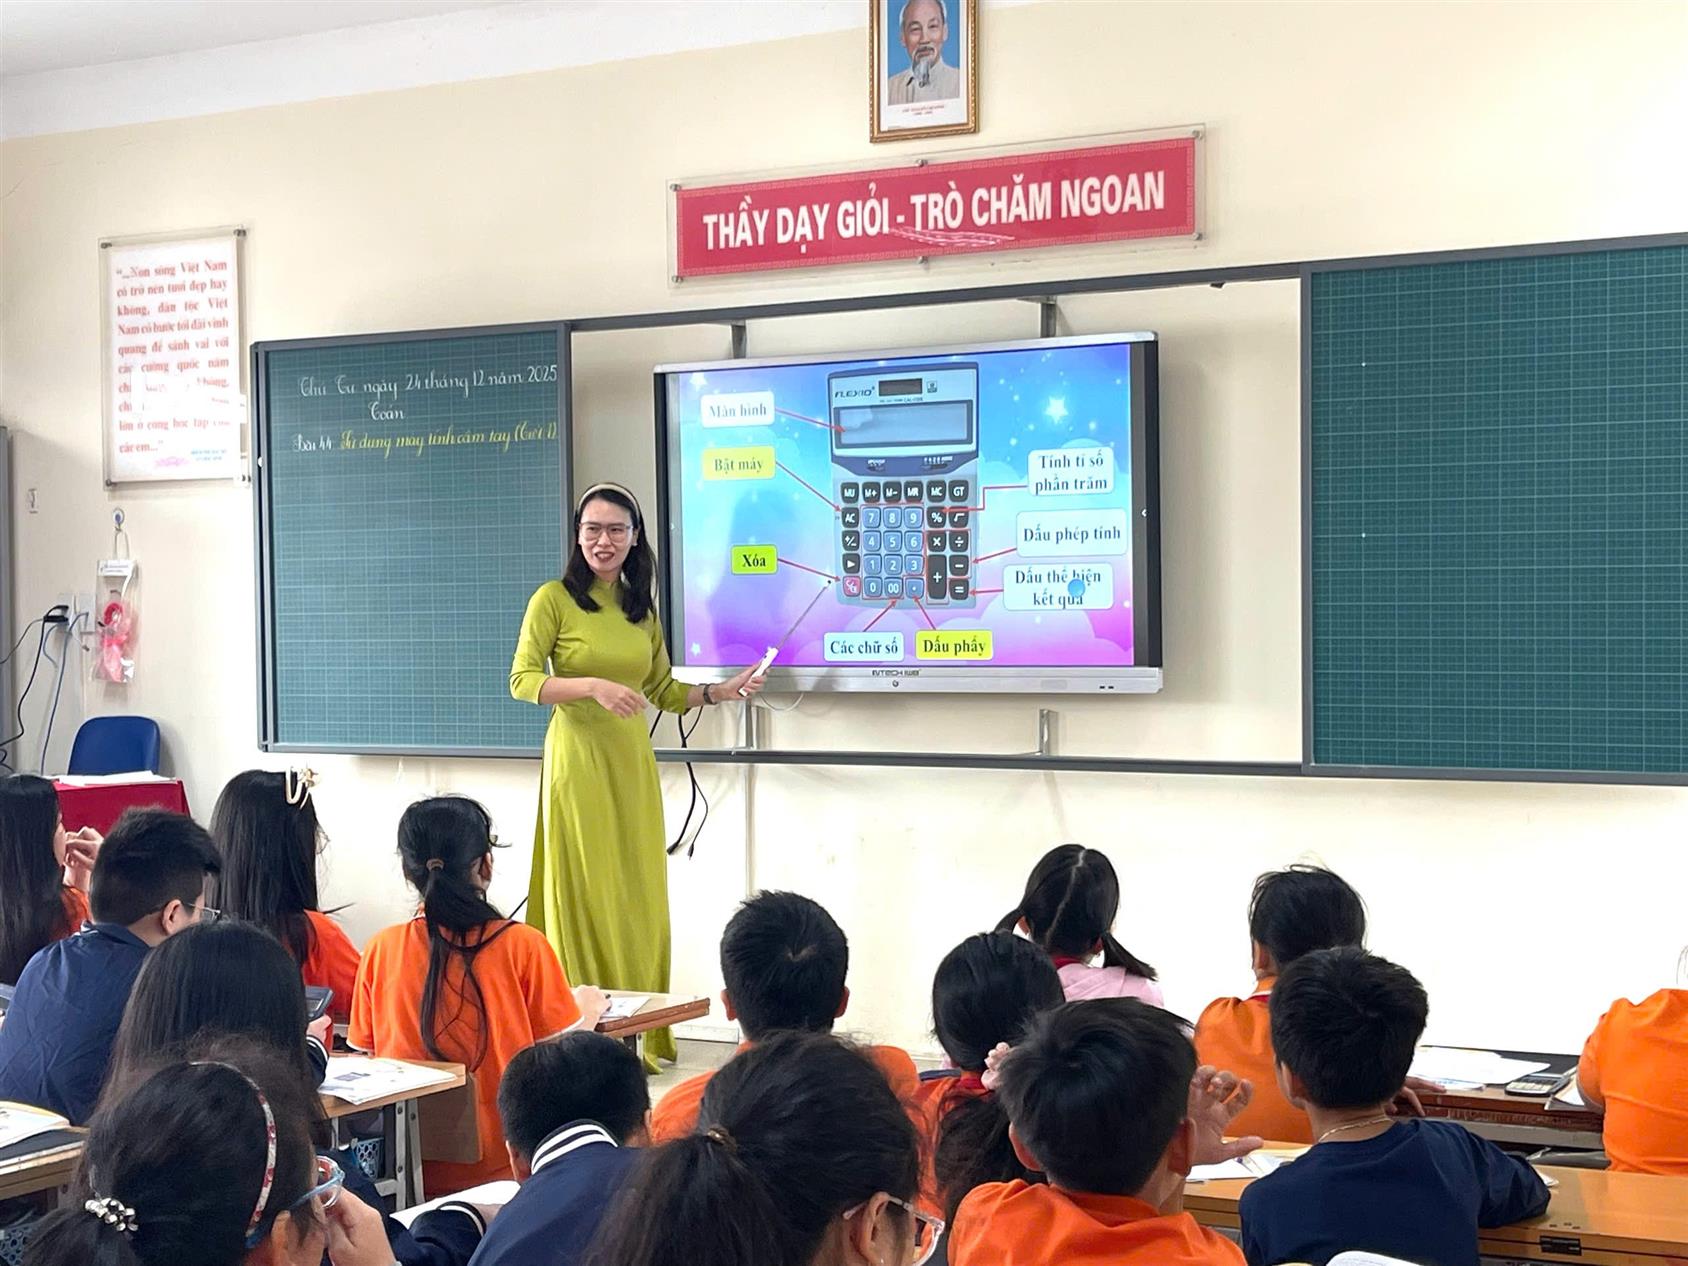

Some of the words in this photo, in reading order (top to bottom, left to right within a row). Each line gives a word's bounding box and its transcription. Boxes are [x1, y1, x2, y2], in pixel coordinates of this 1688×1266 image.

[703, 195, 770, 250] THẦY
[776, 202, 830, 253] DẠY
[837, 183, 890, 238] GIỎI
[910, 181, 964, 232] TRÒ
[971, 174, 1052, 227] CHĂM
[1060, 170, 1166, 218] NGOAN
[364, 380, 398, 400] ngày
[405, 374, 421, 390] 24
[425, 368, 468, 398] tháng
[473, 369, 485, 386] 12
[488, 372, 523, 386] năm
[527, 365, 557, 382] 2025
[368, 401, 405, 420] Toán
[709, 405, 736, 418] Màn
[740, 403, 767, 417] hình
[489, 430, 510, 453] tay
[714, 458, 735, 475] Bật
[738, 456, 763, 473] máy
[1038, 455, 1070, 469] Tính
[1089, 449, 1104, 467] số
[953, 487, 965, 497] GT
[1035, 474, 1069, 495] phần
[1074, 476, 1107, 490] trăm
[845, 513, 855, 523] AC
[868, 513, 875, 523] 7
[889, 513, 896, 523] 8
[910, 513, 917, 523] 9
[931, 513, 943, 523] %
[868, 537, 875, 547] 4
[890, 537, 896, 547] 5
[910, 537, 917, 547] 6
[1023, 523, 1050, 542] Dấu
[1056, 526, 1089, 544] phép
[1094, 525, 1121, 540] tính
[742, 553, 766, 568] Xóa
[870, 560, 875, 569] 1
[890, 560, 896, 570] 2
[911, 560, 917, 570] 3
[1015, 565, 1042, 584] Dấu
[1047, 564, 1068, 583] thể
[870, 583, 876, 593] 0
[888, 583, 899, 593] 00
[1033, 587, 1053, 606] kết
[830, 640, 855, 654] Các
[858, 640, 882, 654] chữ
[885, 637, 898, 654] số
[923, 635, 949, 653] Dấu
